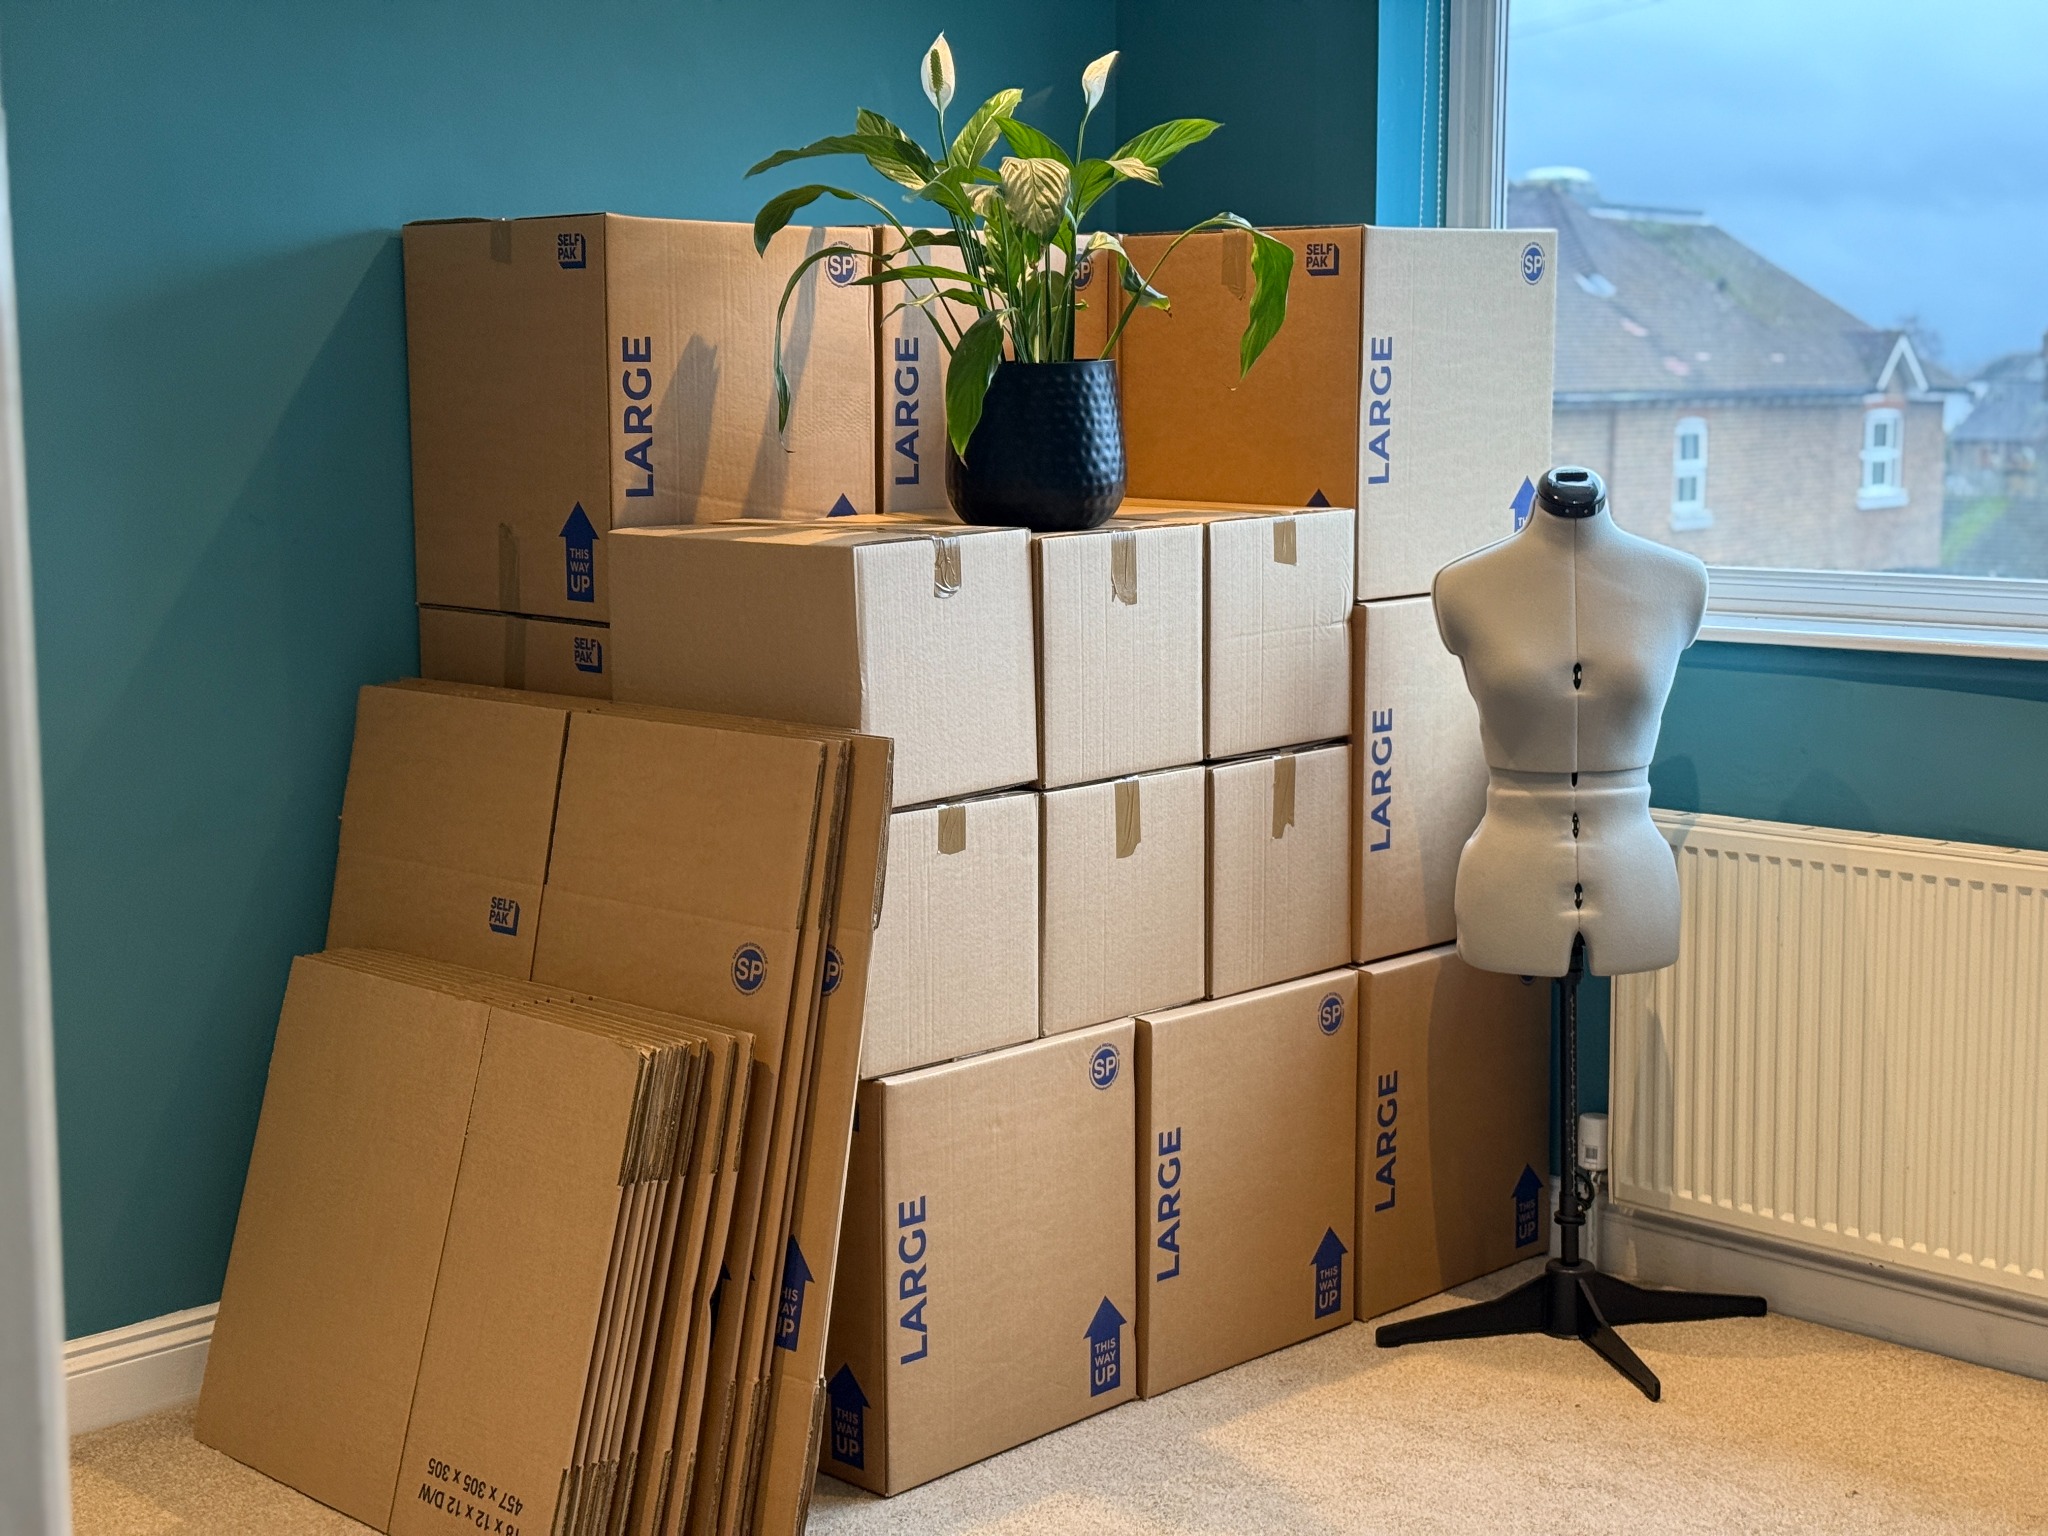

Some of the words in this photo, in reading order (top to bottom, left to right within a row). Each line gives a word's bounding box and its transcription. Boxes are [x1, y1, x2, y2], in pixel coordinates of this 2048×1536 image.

[557, 233, 580, 246] SELF
[1306, 242, 1333, 255] SELF
[557, 246, 577, 260] PAK
[1306, 255, 1328, 268] PAK
[829, 255, 854, 275] SP
[1524, 254, 1541, 274] SP
[622, 336, 654, 497] LARGE
[894, 337, 920, 486] LARGE
[1368, 336, 1394, 485] LARGE
[569, 548, 590, 560] THIS
[570, 561, 590, 573] WAY
[571, 574, 591, 593] UP
[574, 636, 597, 651] SELF
[574, 650, 593, 664] PAK
[1370, 708, 1393, 852] LARGE
[490, 896, 515, 912] SELF
[489, 909, 509, 925] PAK
[736, 957, 763, 982] SP
[1322, 1004, 1341, 1026] SP
[1093, 1055, 1116, 1079] SP
[1375, 1070, 1398, 1213] LARGE
[1157, 1127, 1182, 1283] LARGE
[1519, 1221, 1536, 1239] UP
[899, 1195, 928, 1365] LARGE
[1320, 1265, 1338, 1280] THIS
[1319, 1276, 1338, 1291] WAY
[782, 1287, 799, 1302] HIS
[1319, 1289, 1338, 1309] UP
[781, 1302, 797, 1317] AY
[1094, 1337, 1117, 1354] THIS
[1094, 1349, 1117, 1367] WAY
[1095, 1363, 1117, 1386] UP
[835, 1407, 859, 1425] THIS
[835, 1420, 859, 1438] WAY
[836, 1434, 859, 1457] UP
[427, 1457, 450, 1482] 305
[452, 1469, 461, 1484] x
[462, 1474, 486, 1499] 305
[488, 1486, 498, 1501] x
[418, 1483, 445, 1510] D/W
[498, 1493, 523, 1516] 457
[446, 1496, 461, 1517] 12
[465, 1504, 475, 1520] x
[475, 1510, 490, 1531] 12
[494, 1518, 504, 1534] x
